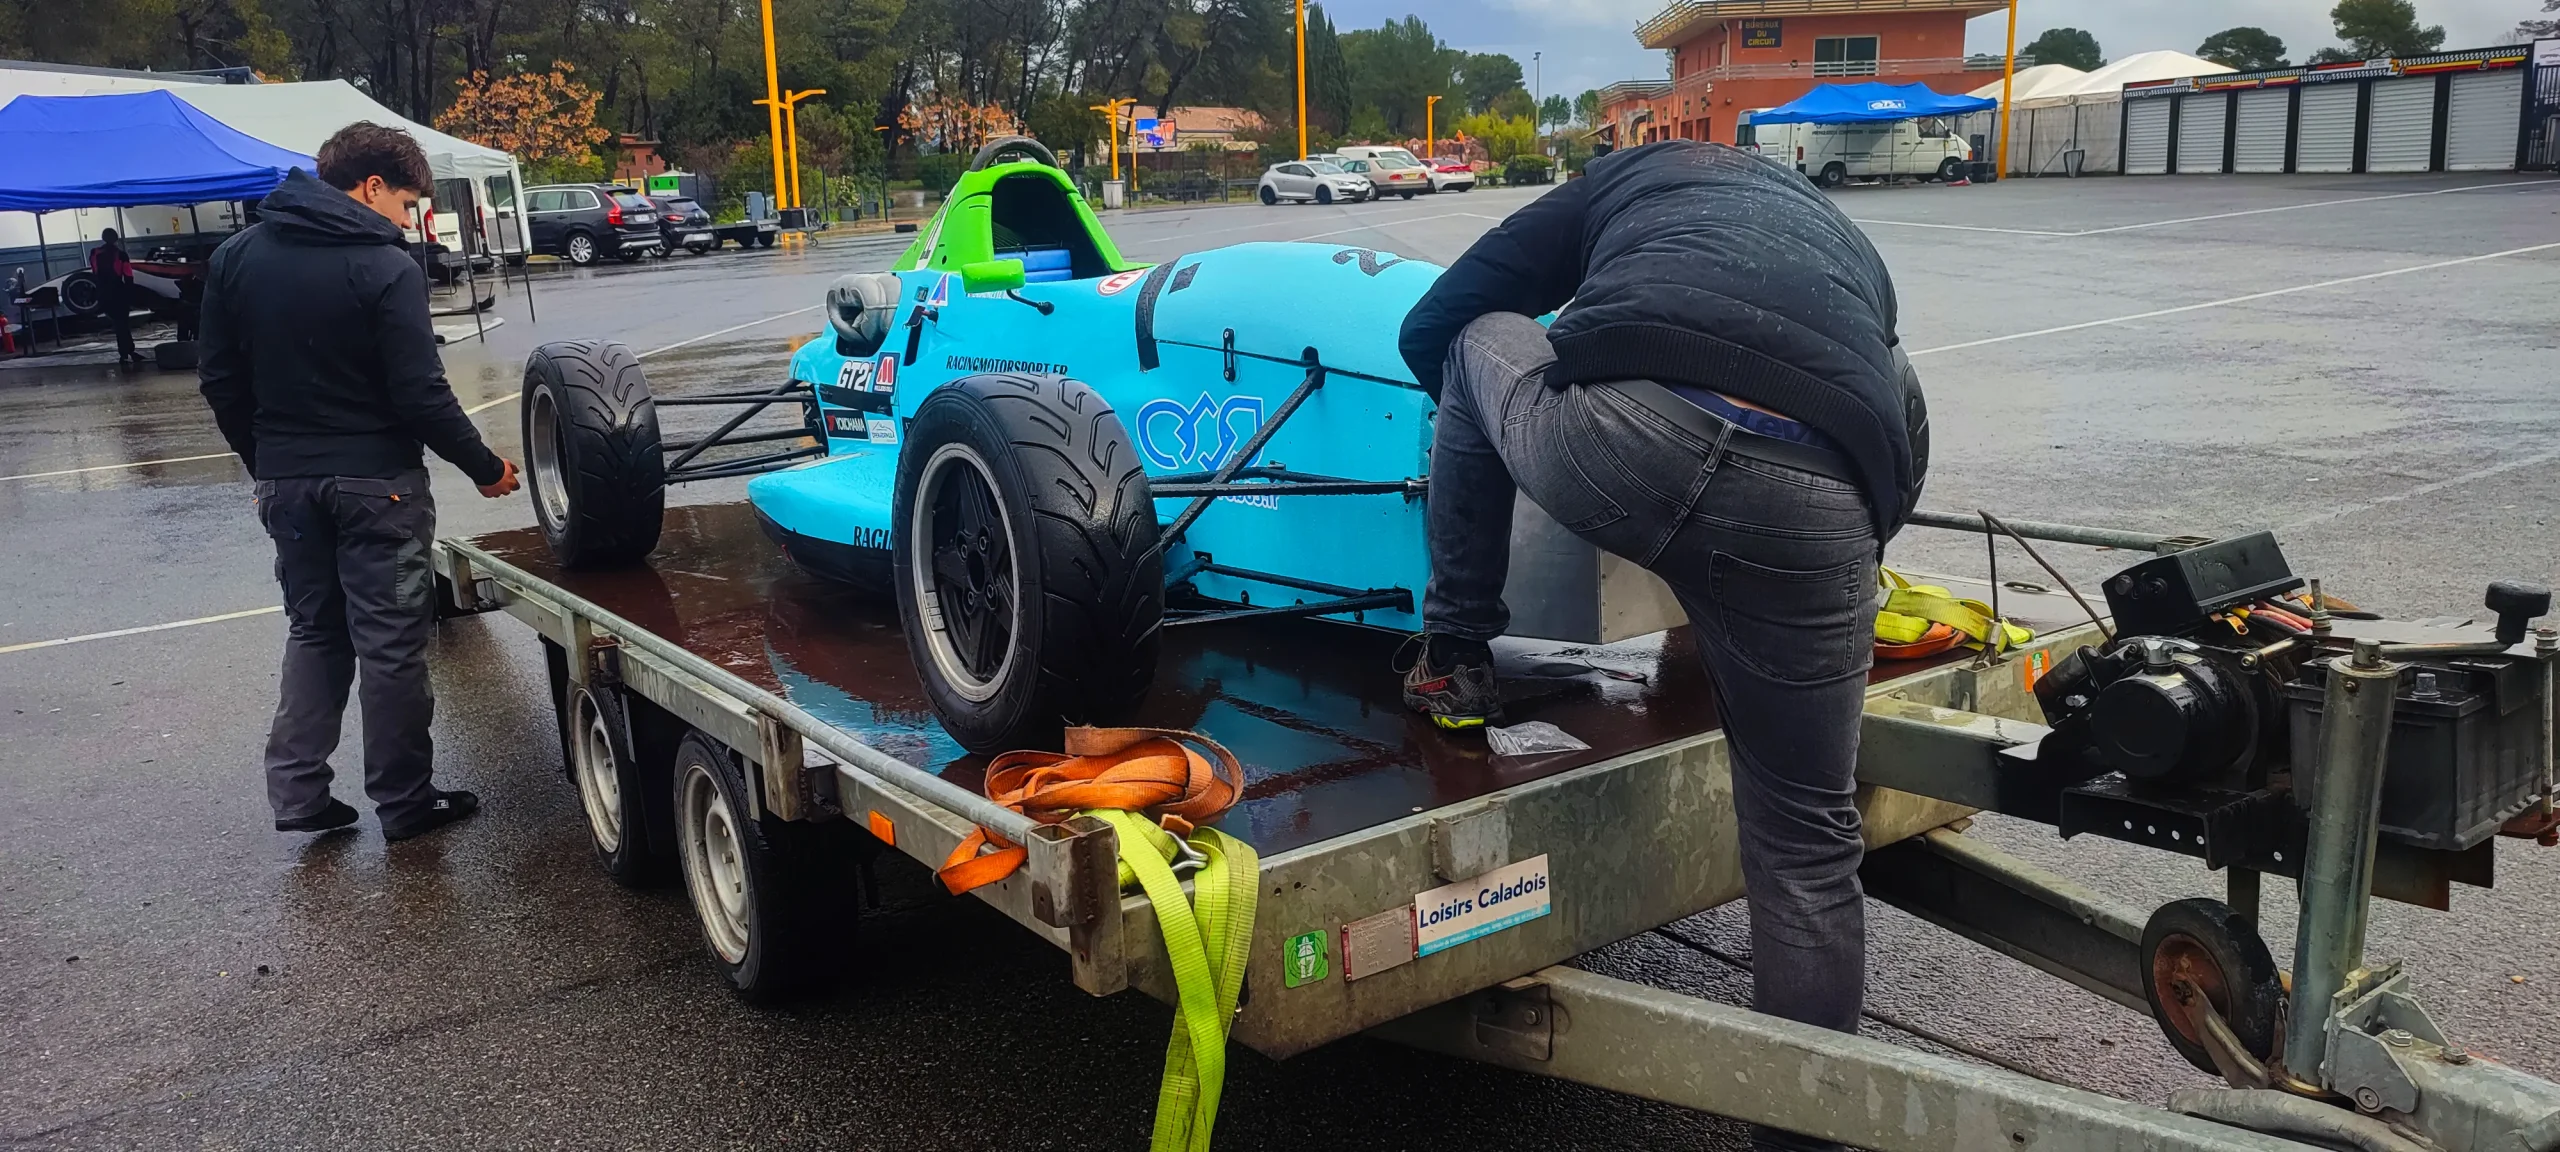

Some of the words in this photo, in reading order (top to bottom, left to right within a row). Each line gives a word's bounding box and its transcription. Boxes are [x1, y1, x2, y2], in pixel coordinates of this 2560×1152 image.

[946, 355, 1068, 375] RACINGMOTORSPORTFR
[834, 416, 866, 432] YOKOHAMA
[1420, 898, 1472, 928] Loisirs
[1478, 873, 1546, 908] Caladois
